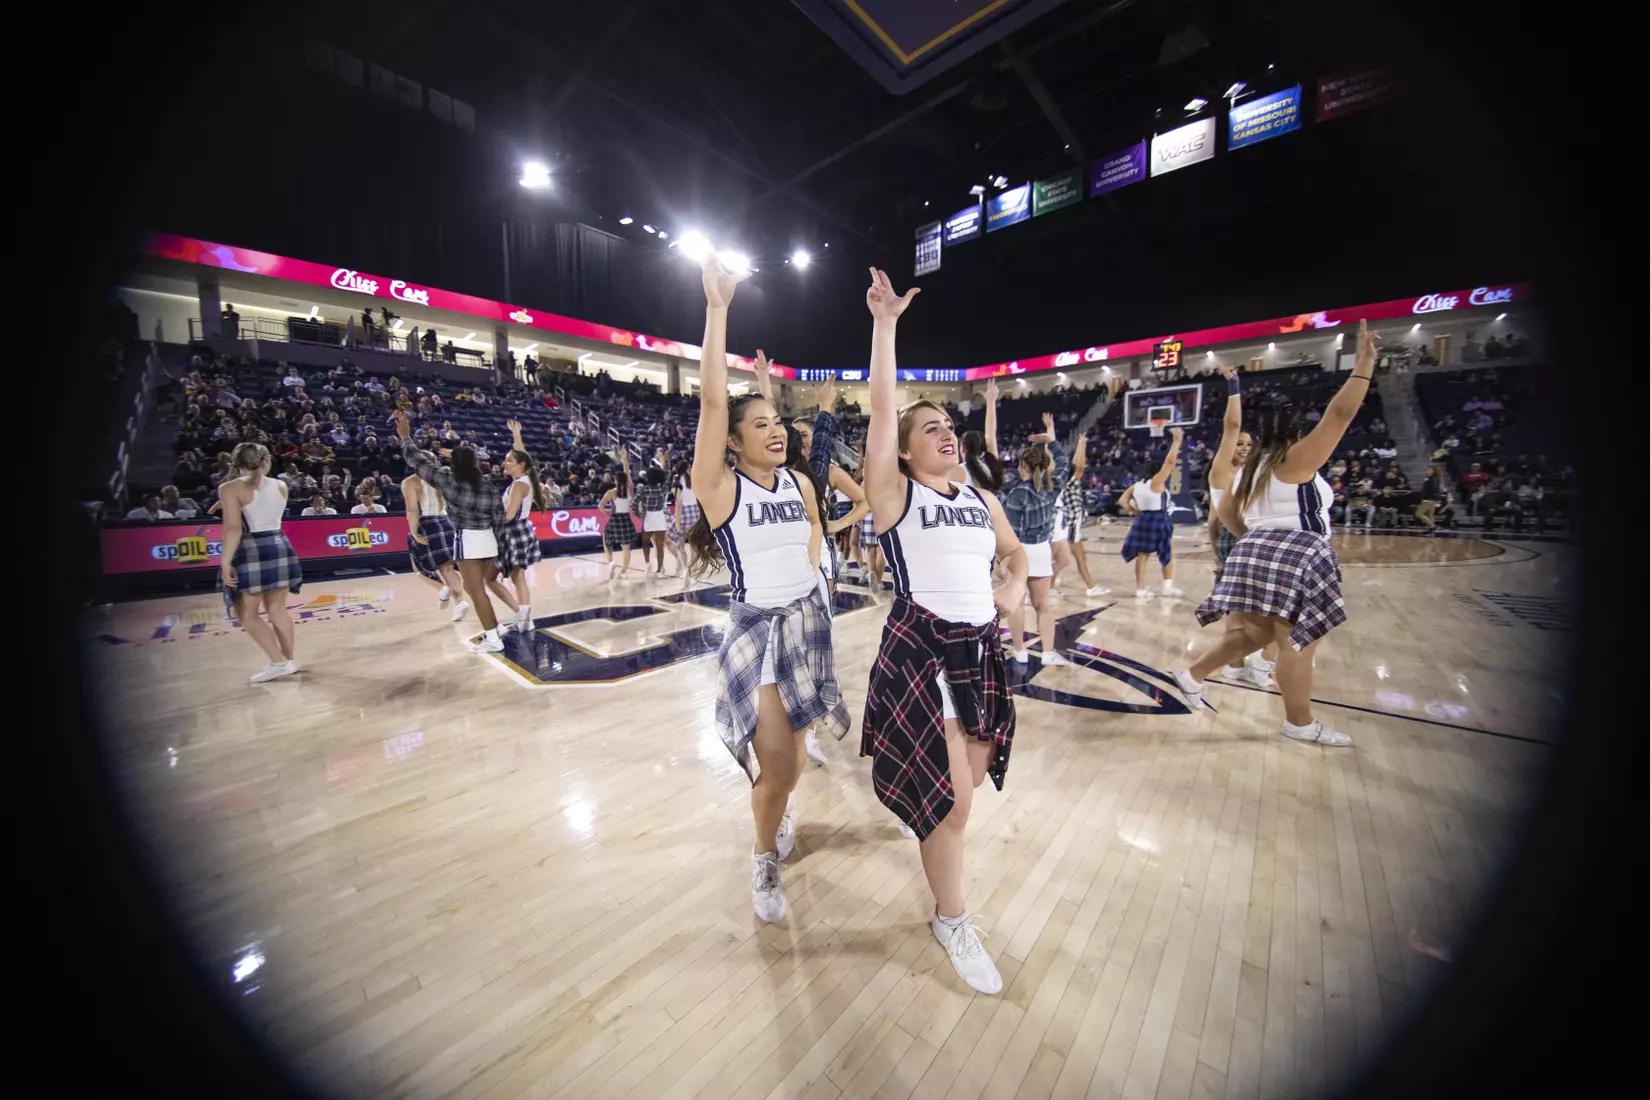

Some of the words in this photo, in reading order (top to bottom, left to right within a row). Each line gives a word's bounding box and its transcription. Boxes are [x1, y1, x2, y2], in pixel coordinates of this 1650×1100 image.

[1233, 122, 1247, 132] OF
[1248, 105, 1297, 127] MISSOURI
[1236, 97, 1293, 122] UNIVERSITY
[1233, 123, 1272, 141] KANSAS
[1274, 115, 1297, 127] CITY
[1158, 133, 1206, 162] WAC
[1101, 163, 1133, 178] CANYON
[1104, 155, 1131, 169] GRAND
[1096, 168, 1139, 188] UNIVERSITY
[330, 268, 380, 296] Kiss
[389, 279, 430, 306] Cam
[1412, 293, 1459, 314] Kiss
[1469, 286, 1513, 306] Cam
[1158, 351, 1178, 367] 23
[842, 370, 862, 380] CBU
[551, 510, 602, 537] Cam
[745, 500, 811, 527] LANCER
[917, 505, 994, 530] LANCER
[333, 531, 385, 549] spOILed
